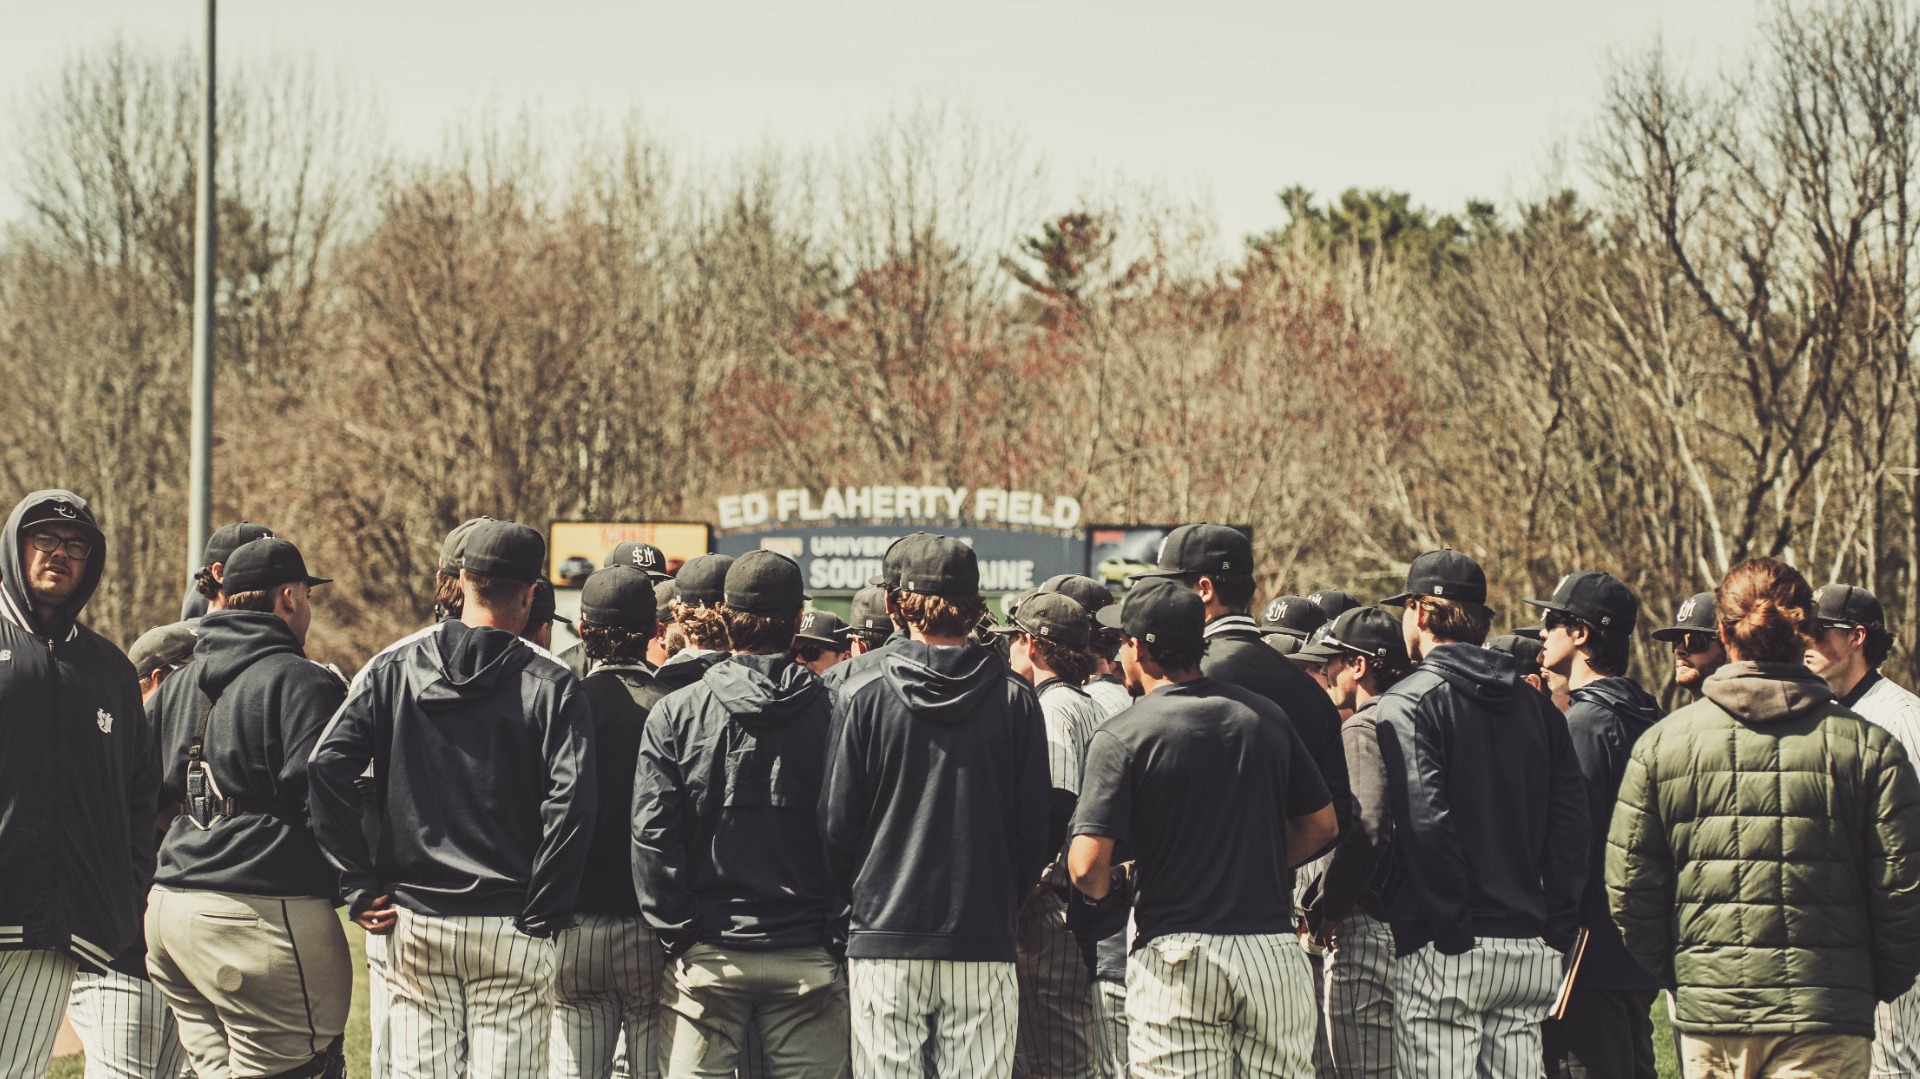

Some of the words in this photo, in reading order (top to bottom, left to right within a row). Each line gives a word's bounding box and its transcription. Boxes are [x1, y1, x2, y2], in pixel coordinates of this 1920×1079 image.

[718, 493, 769, 528] ED
[776, 485, 967, 522] FLAHERTY
[974, 488, 1081, 529] FIELD
